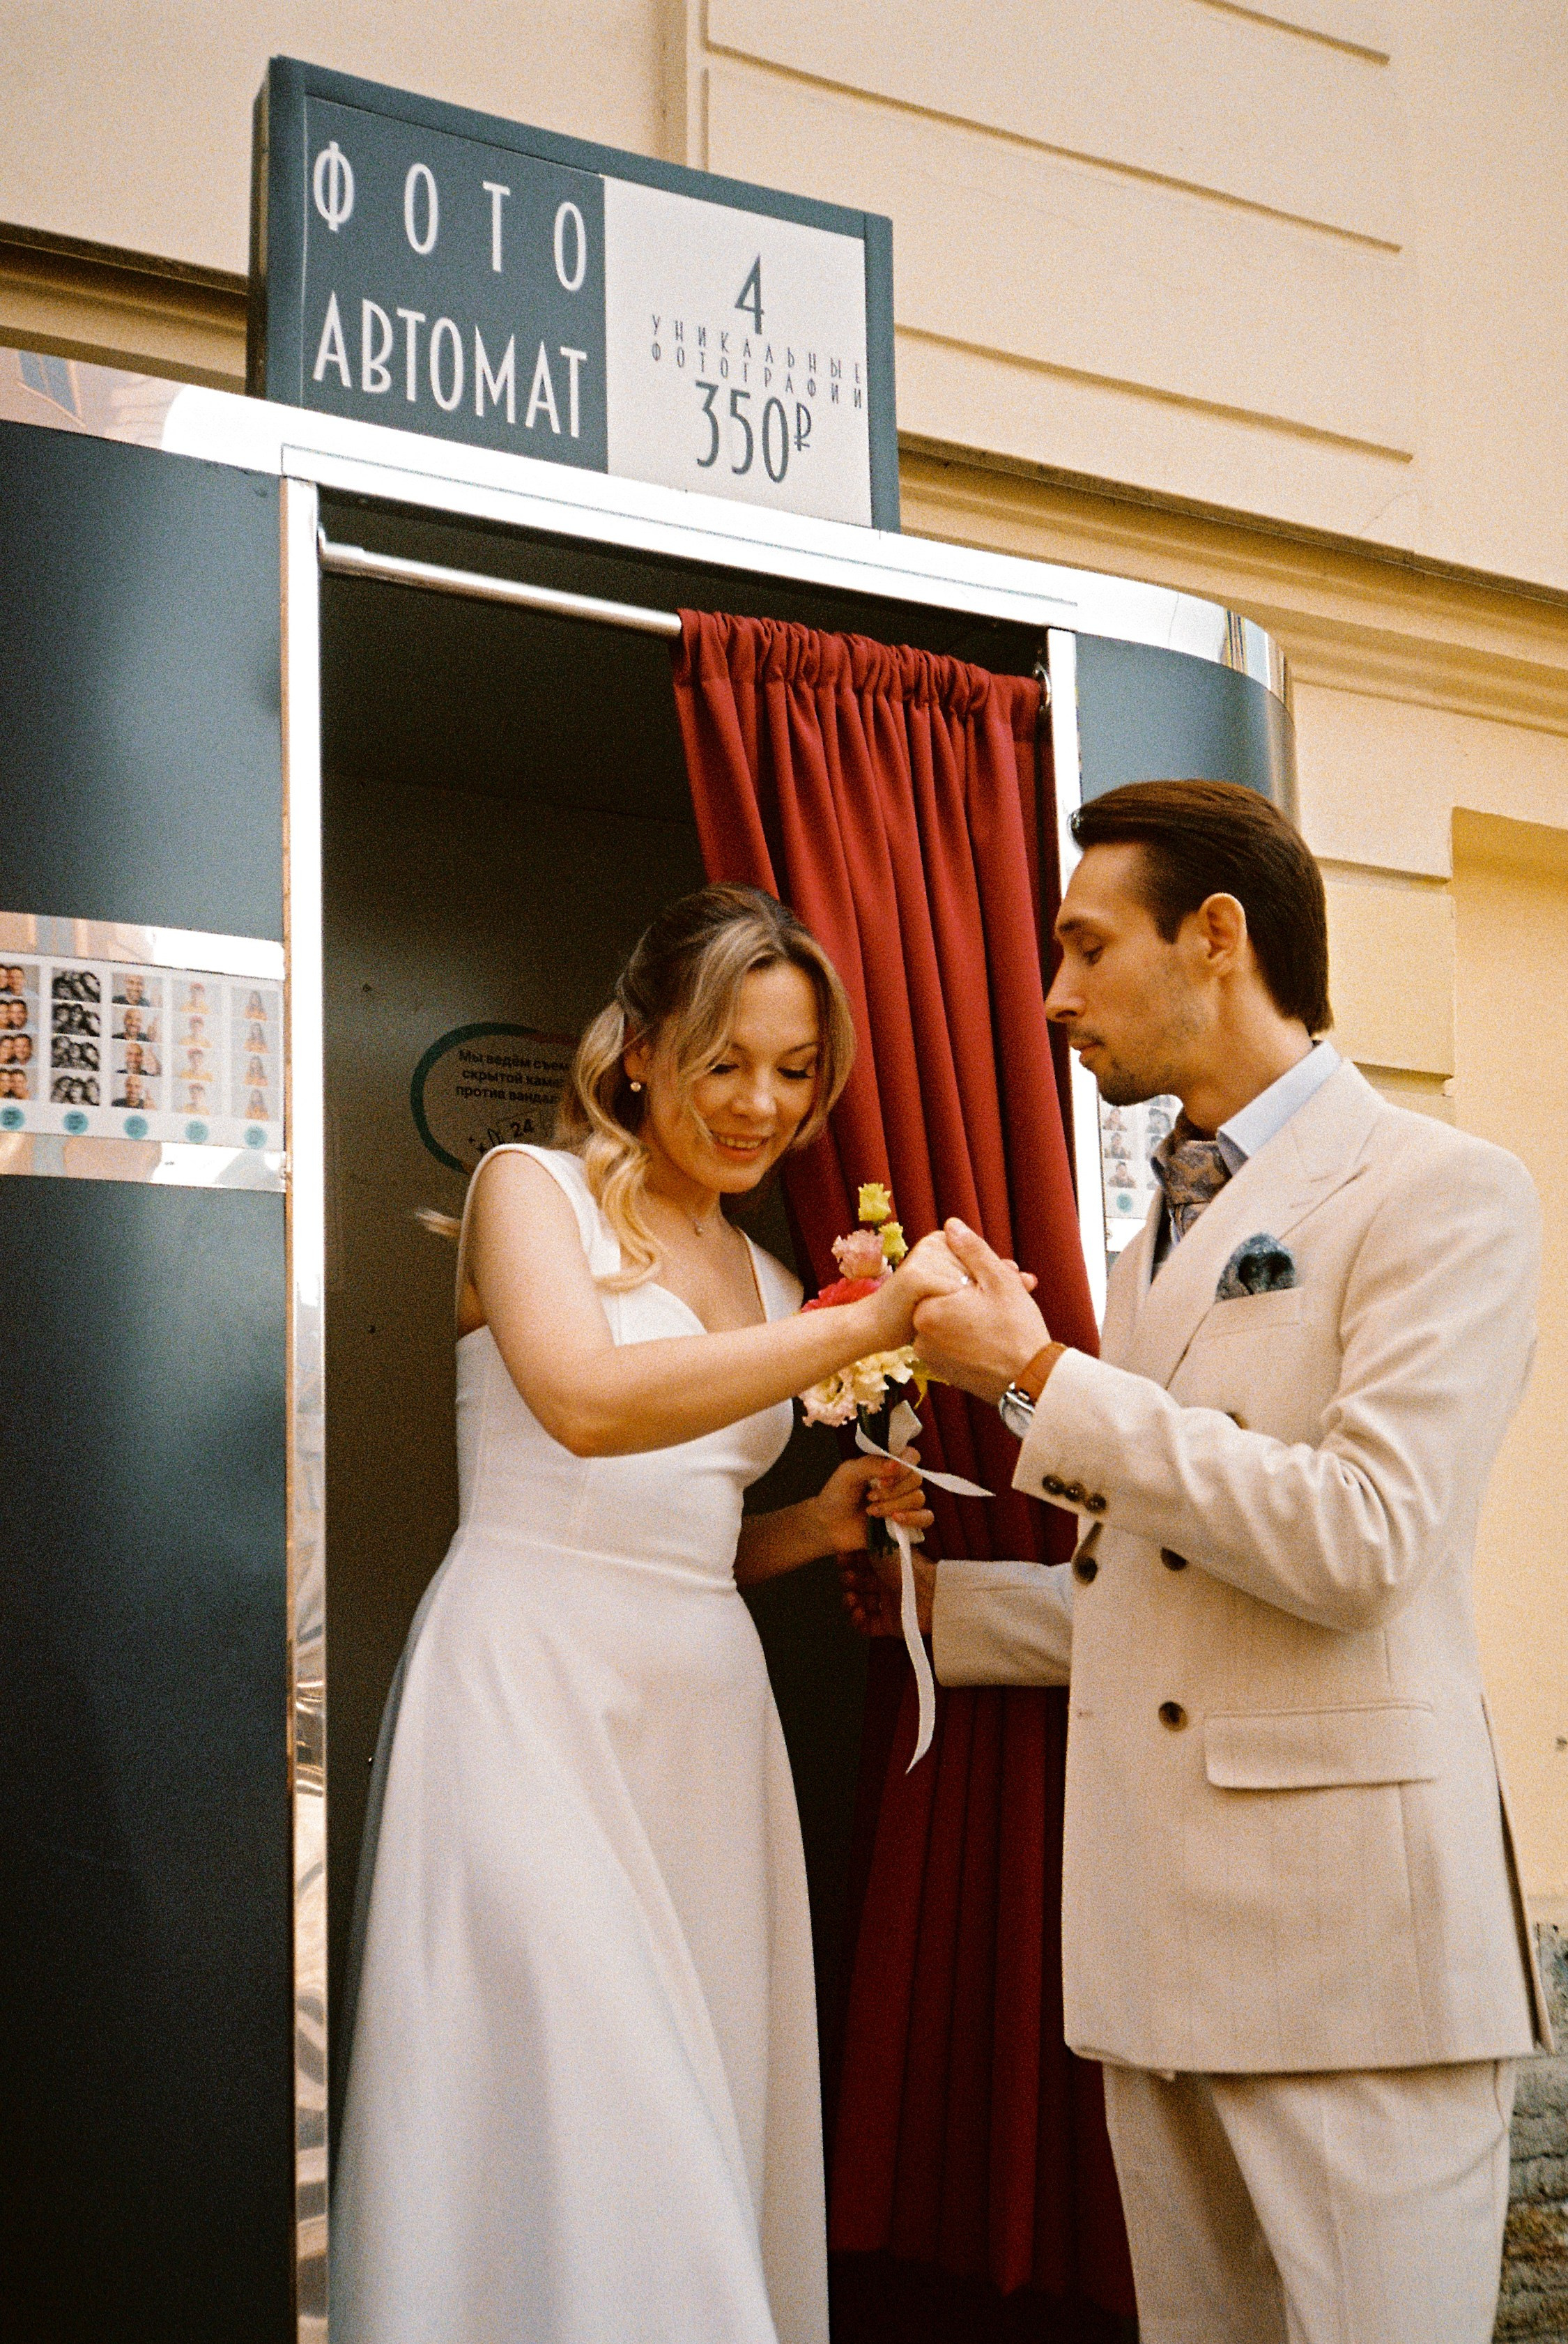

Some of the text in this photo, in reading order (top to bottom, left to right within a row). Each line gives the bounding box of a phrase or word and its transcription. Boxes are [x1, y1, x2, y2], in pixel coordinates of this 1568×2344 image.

[313, 141, 587, 291] ФОТО
[734, 252, 765, 335] 4
[312, 290, 587, 438] АВТОМАТ
[651, 314, 861, 384] УНИКАЛЬНЫЕ
[651, 342, 863, 410] ФОТОГРАФИИ
[459, 1049, 483, 1064] Мы
[461, 1070, 523, 1085] скрытой
[456, 1086, 505, 1099] против
